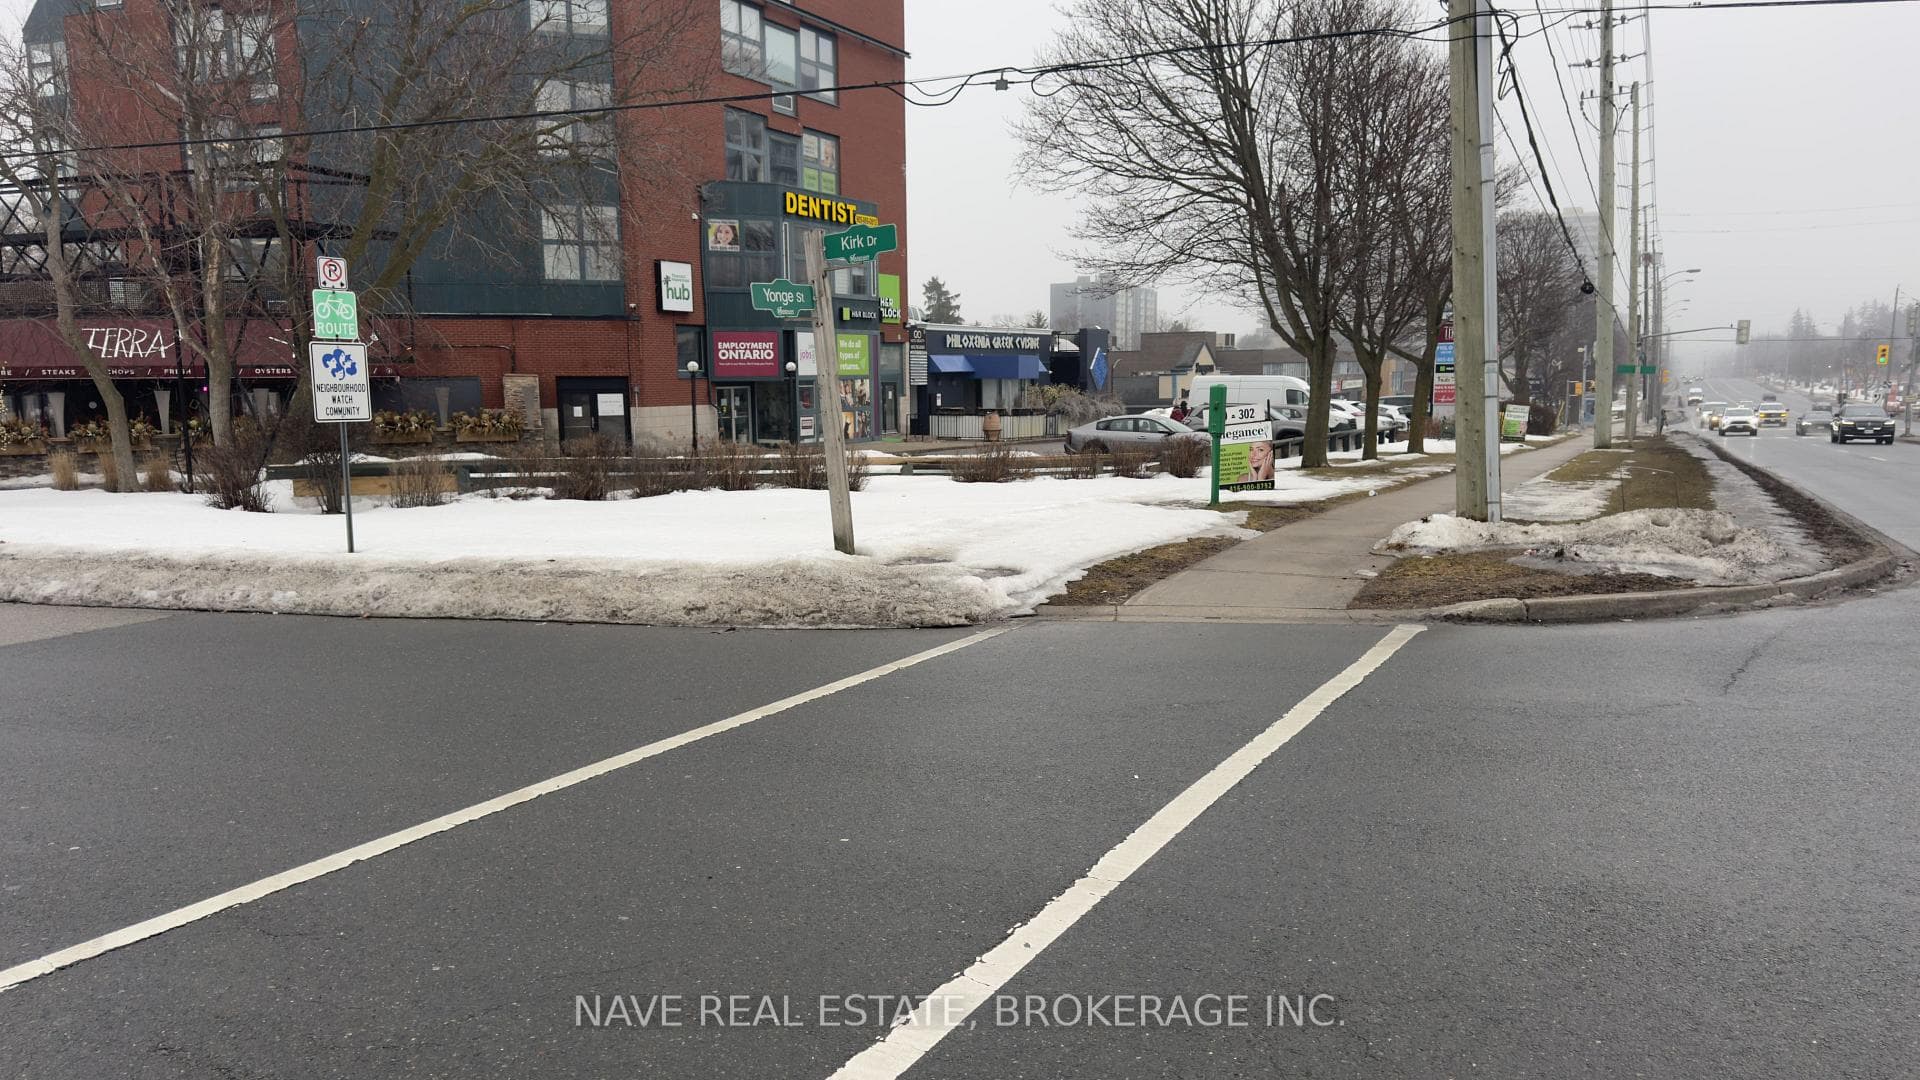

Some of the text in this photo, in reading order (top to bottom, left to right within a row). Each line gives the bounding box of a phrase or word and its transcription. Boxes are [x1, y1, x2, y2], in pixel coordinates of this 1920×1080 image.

[786, 192, 856, 224] DENTIST
[841, 235, 877, 251] Kirk Dr
[667, 283, 690, 300] hub
[762, 288, 805, 305] Yonge St
[317, 322, 355, 335] ROUTE
[82, 327, 172, 358] TERRA
[992, 336, 1014, 349] GREEK
[718, 350, 774, 359] ONTARIO
[316, 383, 366, 393] NEIGHBOURHOOD
[332, 395, 353, 404] WATCH
[325, 407, 360, 416] COMMUNITY
[1238, 408, 1255, 420] 302
